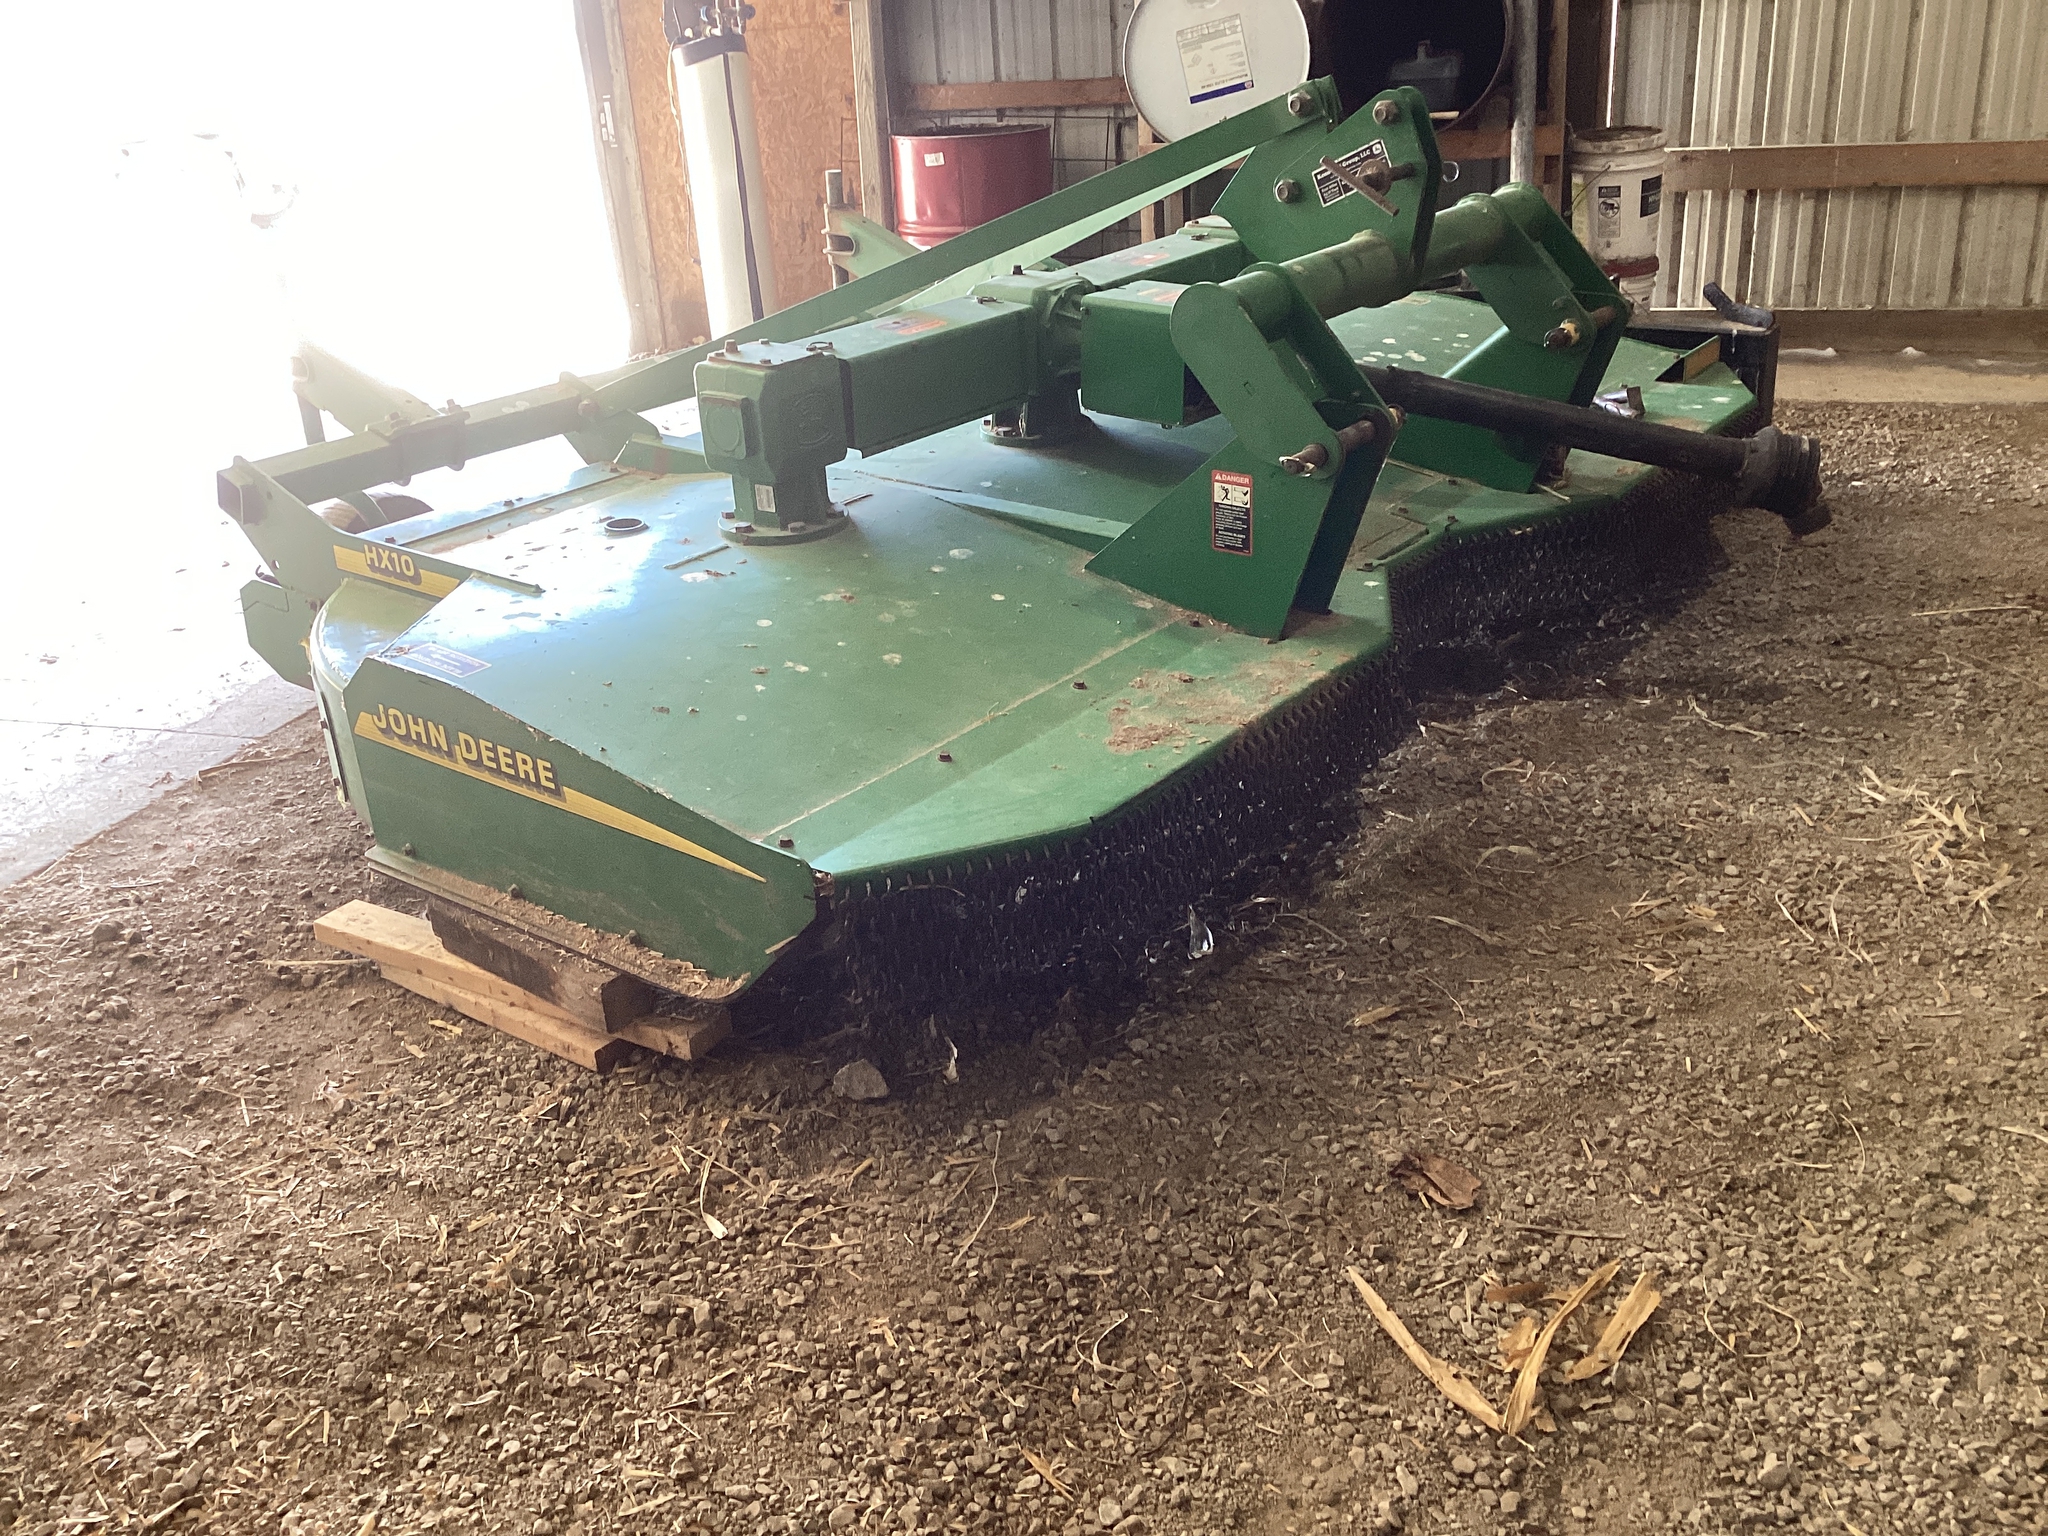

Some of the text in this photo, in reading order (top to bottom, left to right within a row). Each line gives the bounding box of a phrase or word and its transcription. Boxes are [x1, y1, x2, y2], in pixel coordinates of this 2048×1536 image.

[1360, 149, 1371, 158] LLC
[1221, 474, 1250, 484] DANGER
[364, 544, 416, 578] HX10
[372, 703, 557, 790] JOHN DEERE
